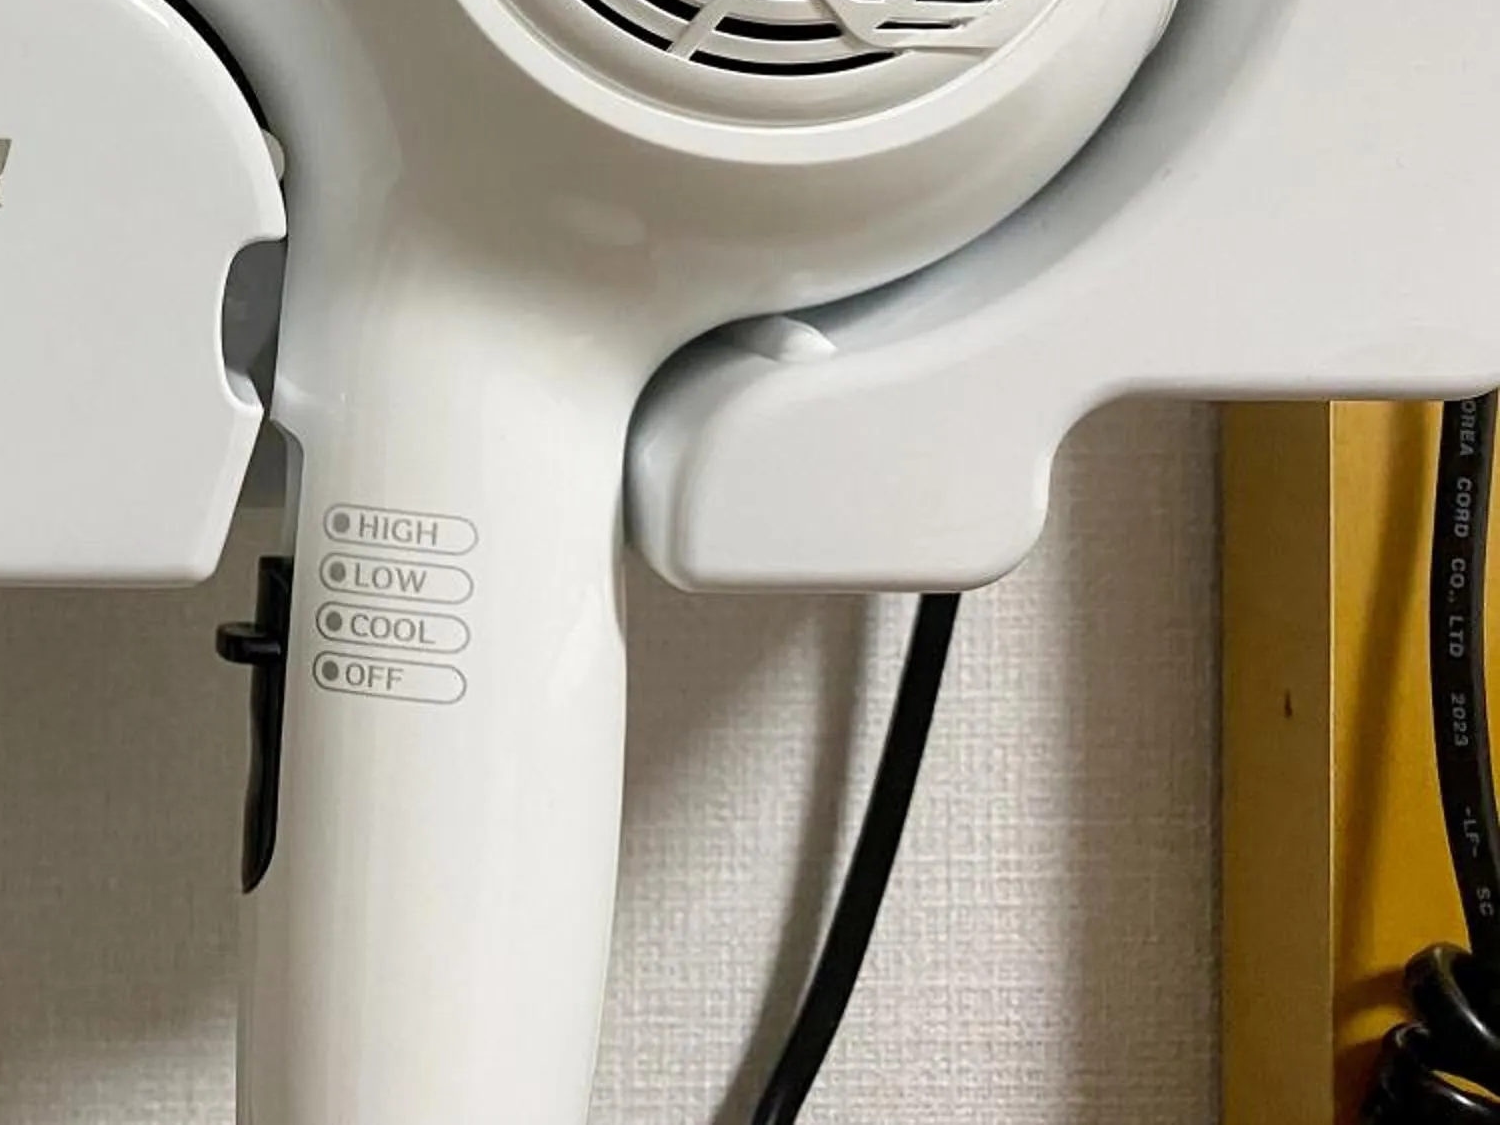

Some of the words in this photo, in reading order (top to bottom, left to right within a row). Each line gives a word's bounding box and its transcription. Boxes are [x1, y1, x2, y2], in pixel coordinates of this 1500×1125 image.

[1460, 399, 1476, 457] OREA
[1454, 477, 1472, 538] CORD
[359, 513, 438, 546] HIGH
[354, 562, 427, 593] LOW
[351, 614, 436, 644] COOL
[1449, 615, 1464, 658] LTD
[346, 663, 404, 690] OFF
[1450, 692, 1468, 747] 2023
